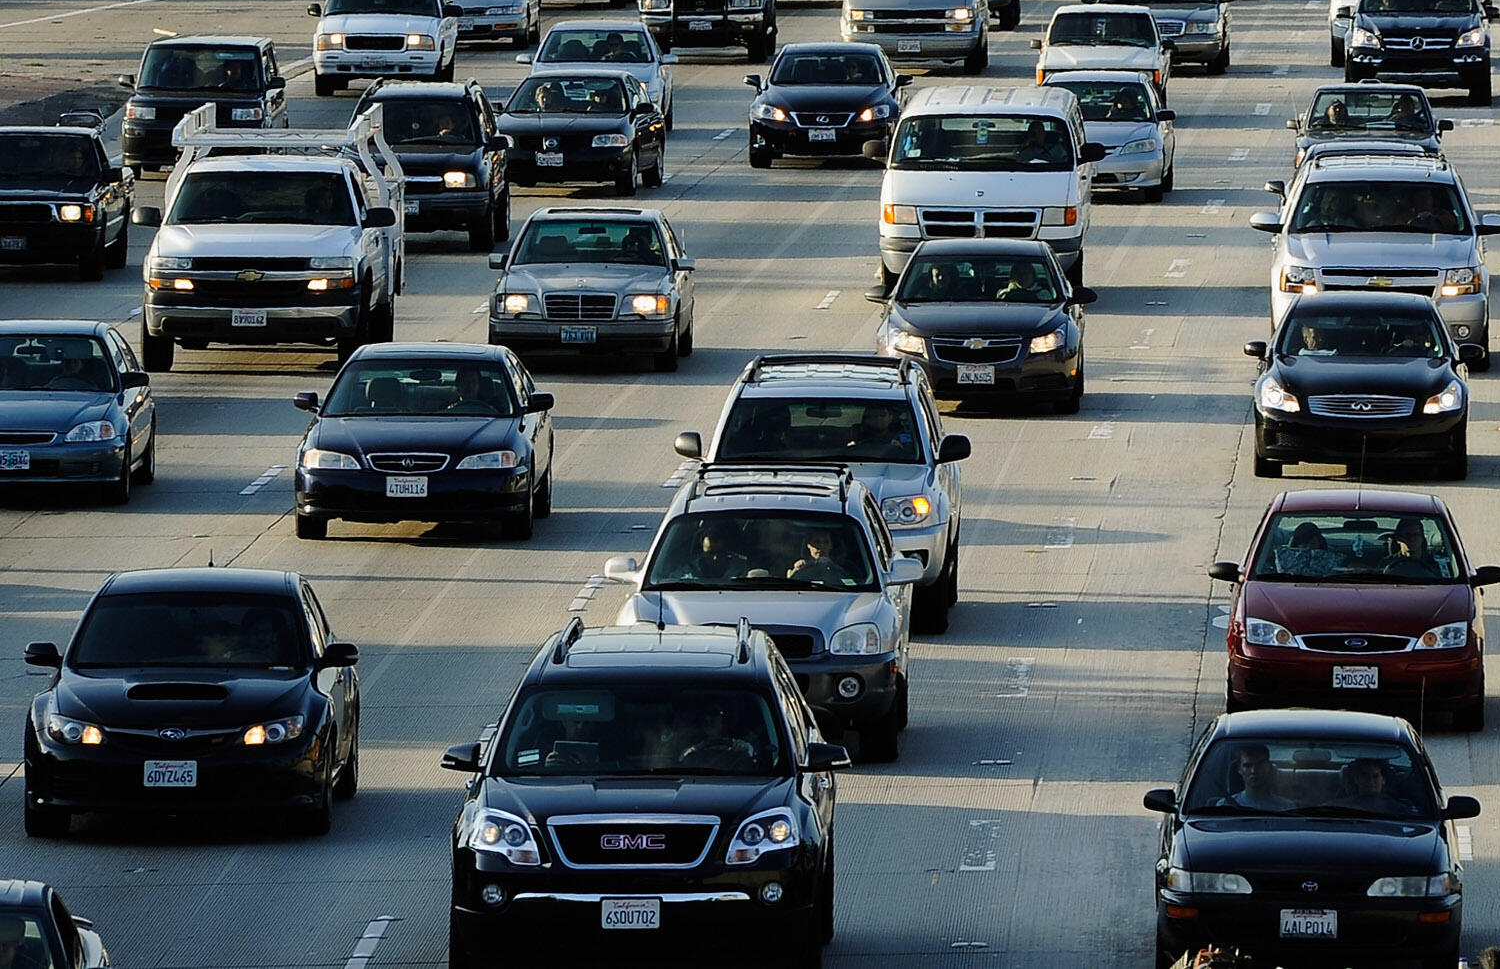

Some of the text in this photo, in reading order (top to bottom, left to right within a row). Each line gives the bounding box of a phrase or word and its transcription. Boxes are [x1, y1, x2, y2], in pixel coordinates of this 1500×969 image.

[388, 484, 426, 495] 4TUH116
[147, 769, 194, 784] 6DYZ465
[600, 834, 666, 850] GMC
[1283, 920, 1334, 936] 4ALP014
